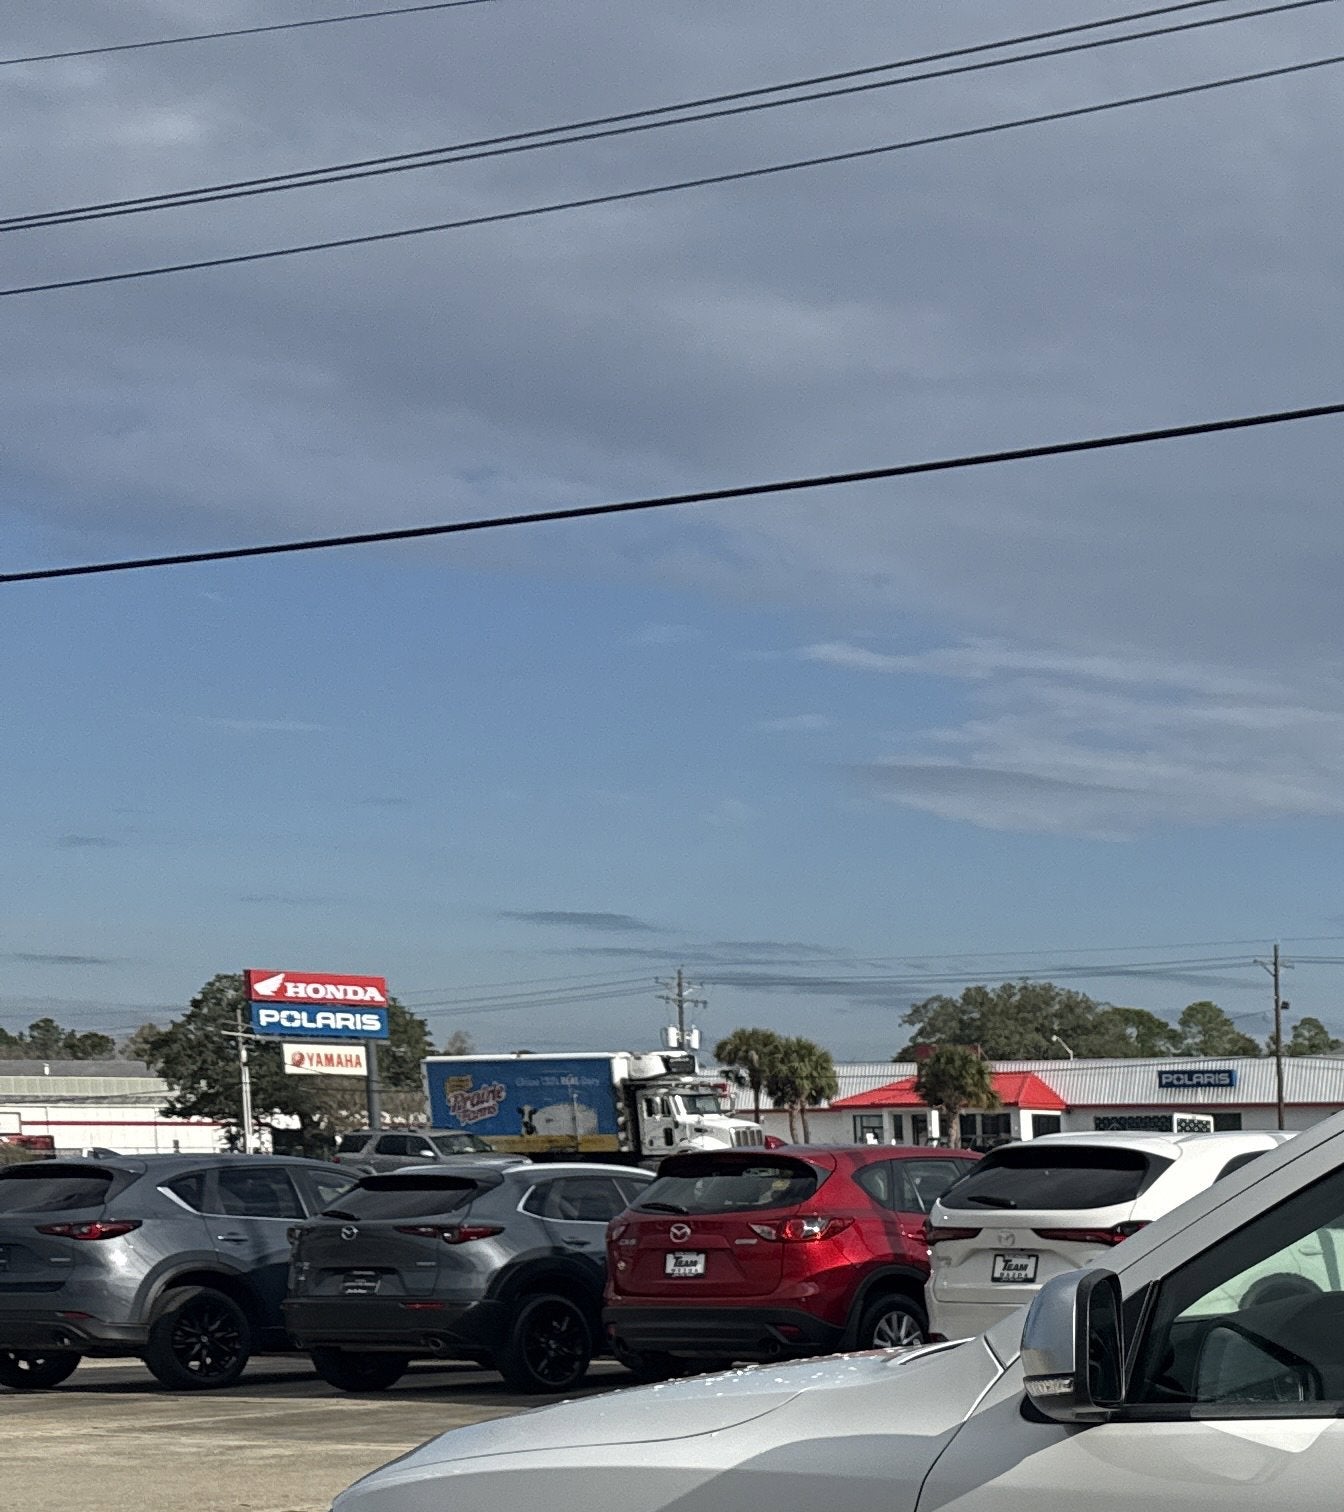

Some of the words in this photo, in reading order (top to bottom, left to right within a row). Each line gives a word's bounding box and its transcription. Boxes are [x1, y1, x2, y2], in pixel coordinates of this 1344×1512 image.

[284, 982, 386, 1002] HONDA
[258, 1009, 382, 1031] POLARIS
[306, 1052, 363, 1069] YAMAHA
[1161, 1072, 1231, 1086] POLARIS
